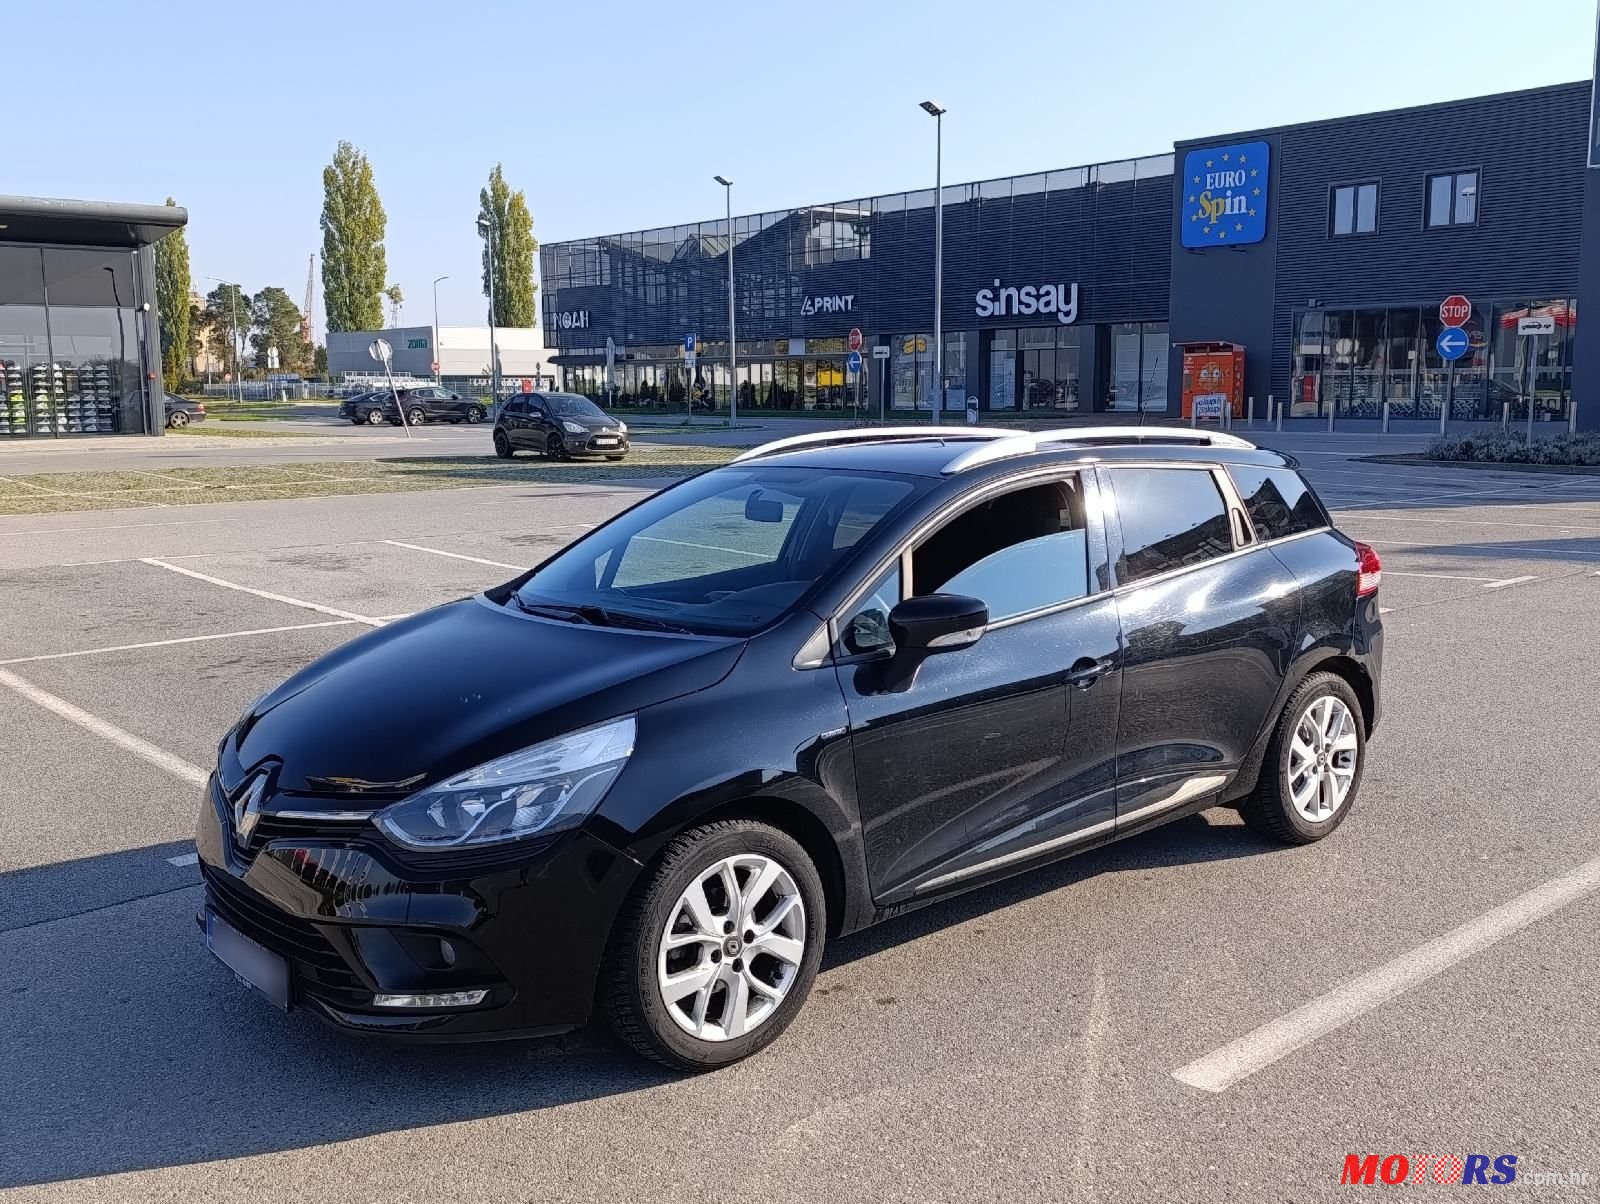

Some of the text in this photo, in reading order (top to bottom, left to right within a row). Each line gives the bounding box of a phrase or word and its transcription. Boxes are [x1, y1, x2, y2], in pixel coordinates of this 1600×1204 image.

[1206, 169, 1246, 190] EURO
[1198, 190, 1248, 225] Spin
[976, 279, 1078, 324] sinsay
[1441, 305, 1469, 318] STOP
[552, 310, 589, 330] NOAH
[687, 336, 693, 349] P
[849, 335, 860, 345] STOP
